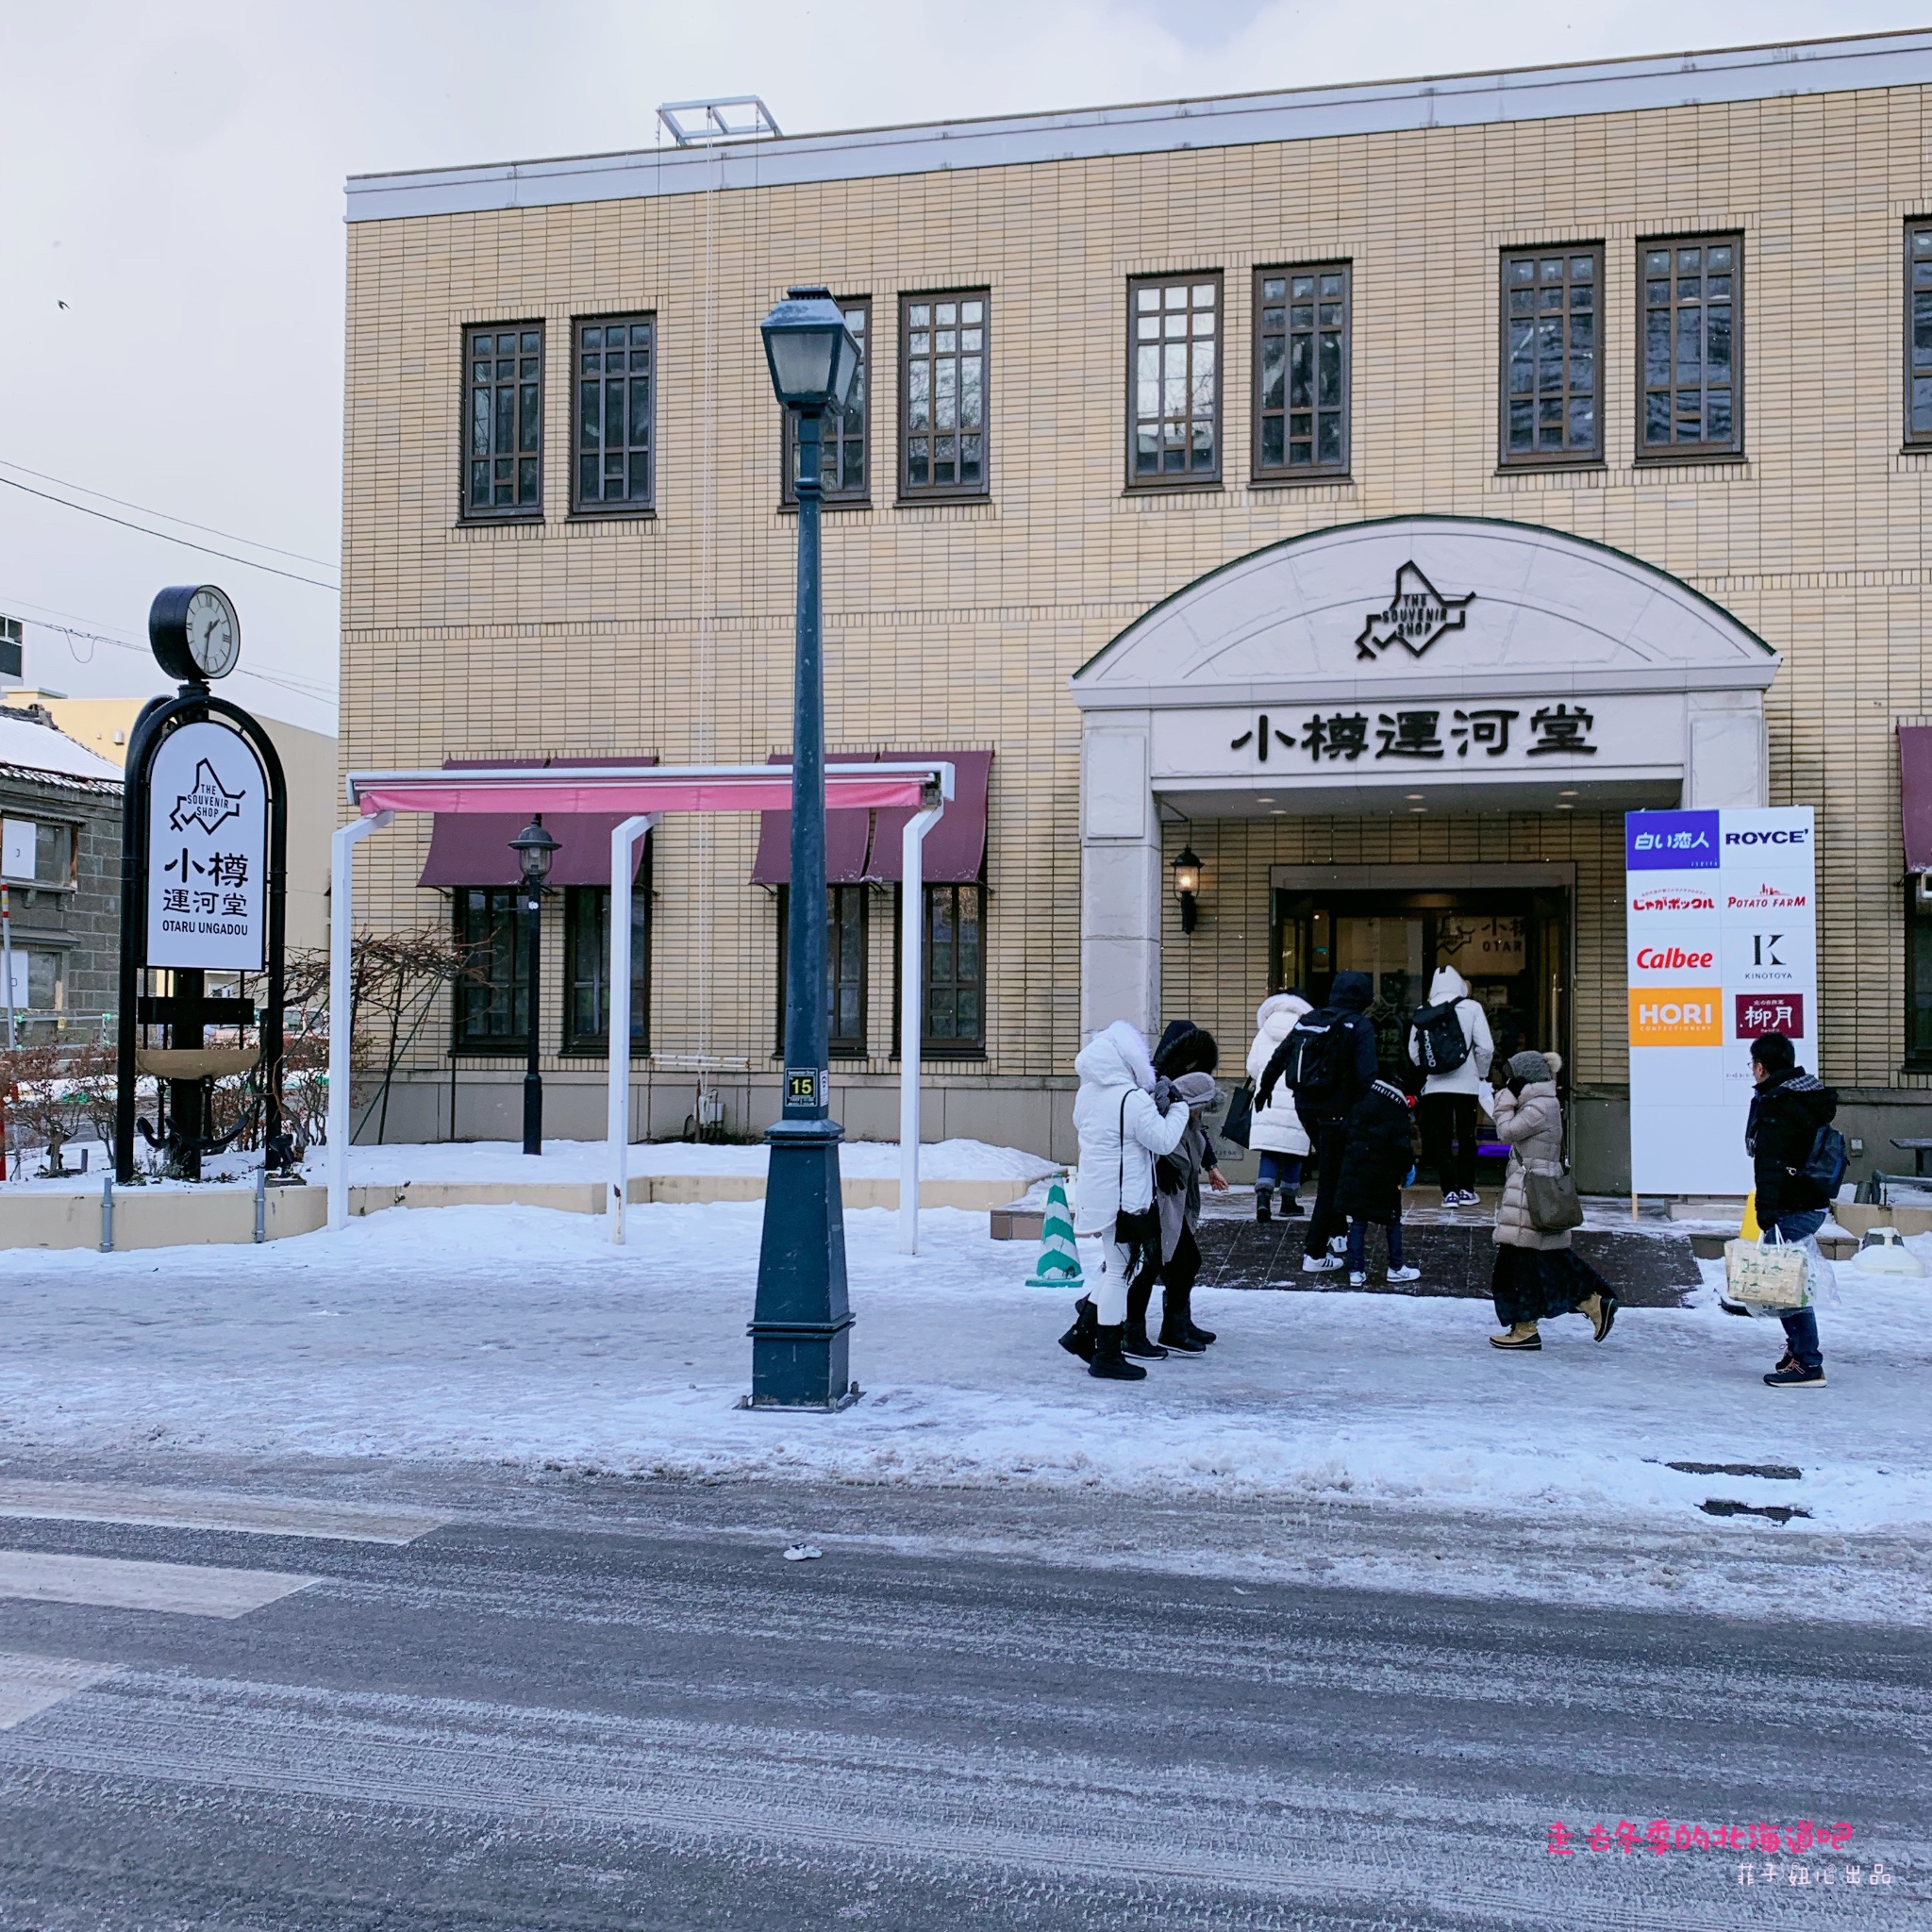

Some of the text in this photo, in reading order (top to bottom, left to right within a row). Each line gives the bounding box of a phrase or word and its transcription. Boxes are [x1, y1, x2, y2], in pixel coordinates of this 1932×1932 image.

[1402, 594, 1427, 607] THE
[1382, 608, 1448, 624] SOUVENIR
[1397, 622, 1432, 637] SHOP
[1230, 703, 1598, 762] 小樽運河堂
[201, 784, 217, 795] THE
[187, 794, 229, 808] SOUVENIR
[196, 807, 219, 818] SHOP
[1634, 831, 1710, 851] 白い恋人
[1725, 828, 1809, 845] ROYCE'
[163, 847, 249, 889] 小樽
[162, 889, 249, 918] 運河堂
[1727, 895, 1807, 908] POTATO FARM
[162, 920, 248, 936] OTARU UNGADOU
[1636, 947, 1713, 969] Calbee
[1753, 934, 1786, 966] K
[1640, 1004, 1712, 1024] HORI
[1744, 1006, 1793, 1028] 柳月
[791, 1078, 812, 1094] 15
